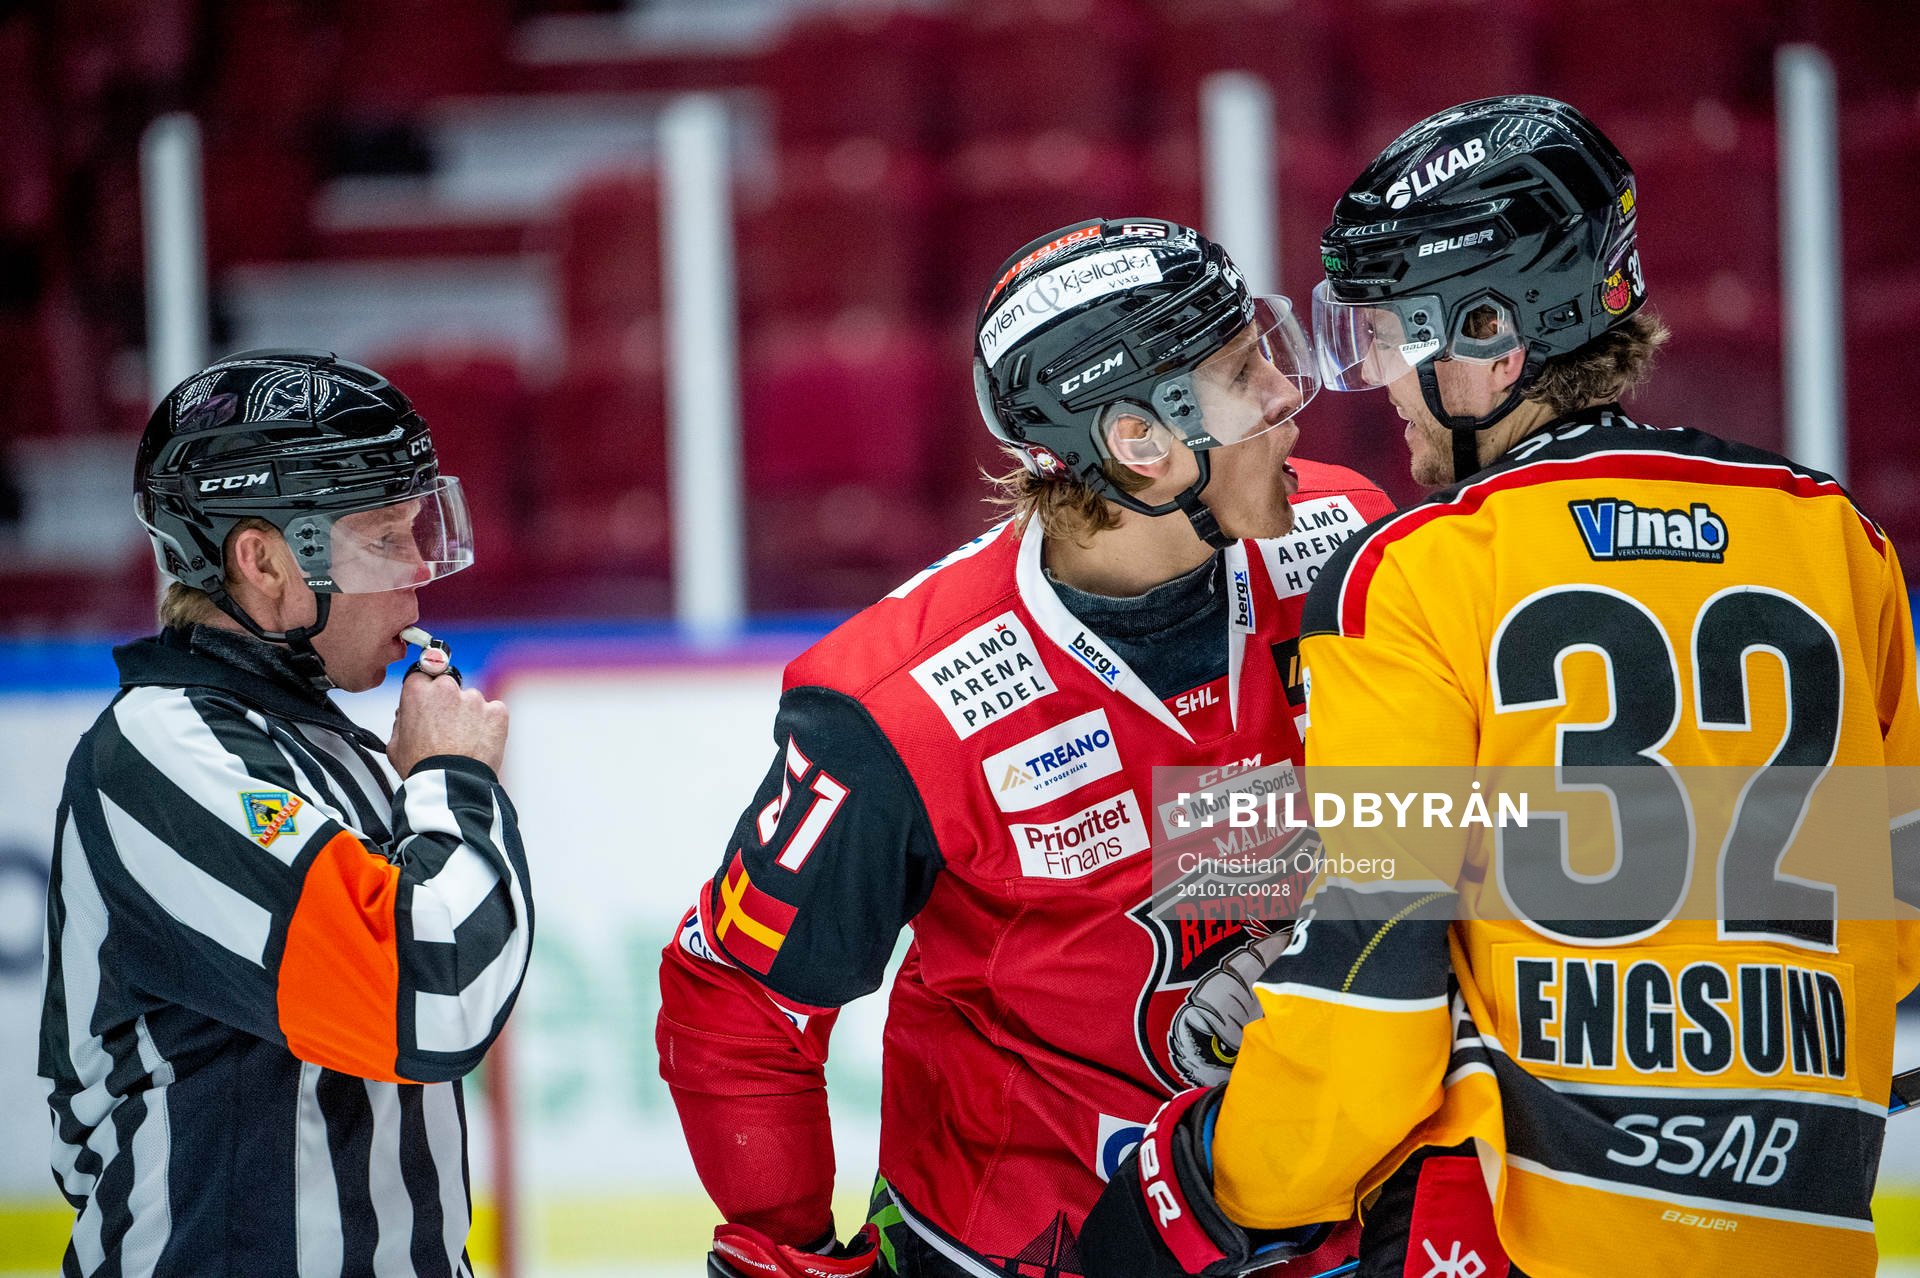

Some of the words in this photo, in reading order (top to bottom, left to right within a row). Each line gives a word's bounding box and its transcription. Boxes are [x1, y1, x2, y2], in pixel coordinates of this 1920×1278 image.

[1410, 137, 1487, 197] LKAB
[1418, 229, 1494, 257] BAUER
[980, 304, 1025, 352] hylén
[1026, 275, 1066, 315] &
[1402, 340, 1437, 352] BAUER
[1060, 351, 1124, 395] CCM
[1187, 435, 1211, 447] CCM
[200, 472, 271, 492] CCM
[1573, 503, 1725, 557] Vinab
[307, 579, 333, 587] CCM
[1234, 571, 1248, 627] bergx
[949, 652, 1034, 706] ARENA
[1072, 632, 1121, 683] bergx
[962, 675, 1046, 728] PADEL
[1175, 686, 1220, 718] SHL
[1025, 729, 1110, 778] TREANO
[1198, 752, 1263, 788] CCM
[1490, 583, 1845, 954] 32
[1024, 800, 1130, 851] Prioritet
[1045, 836, 1123, 876] Finans
[1513, 956, 1848, 1081] ENGSUND
[1606, 1114, 1799, 1187] SSAB
[1660, 1209, 1738, 1233] BAUER
